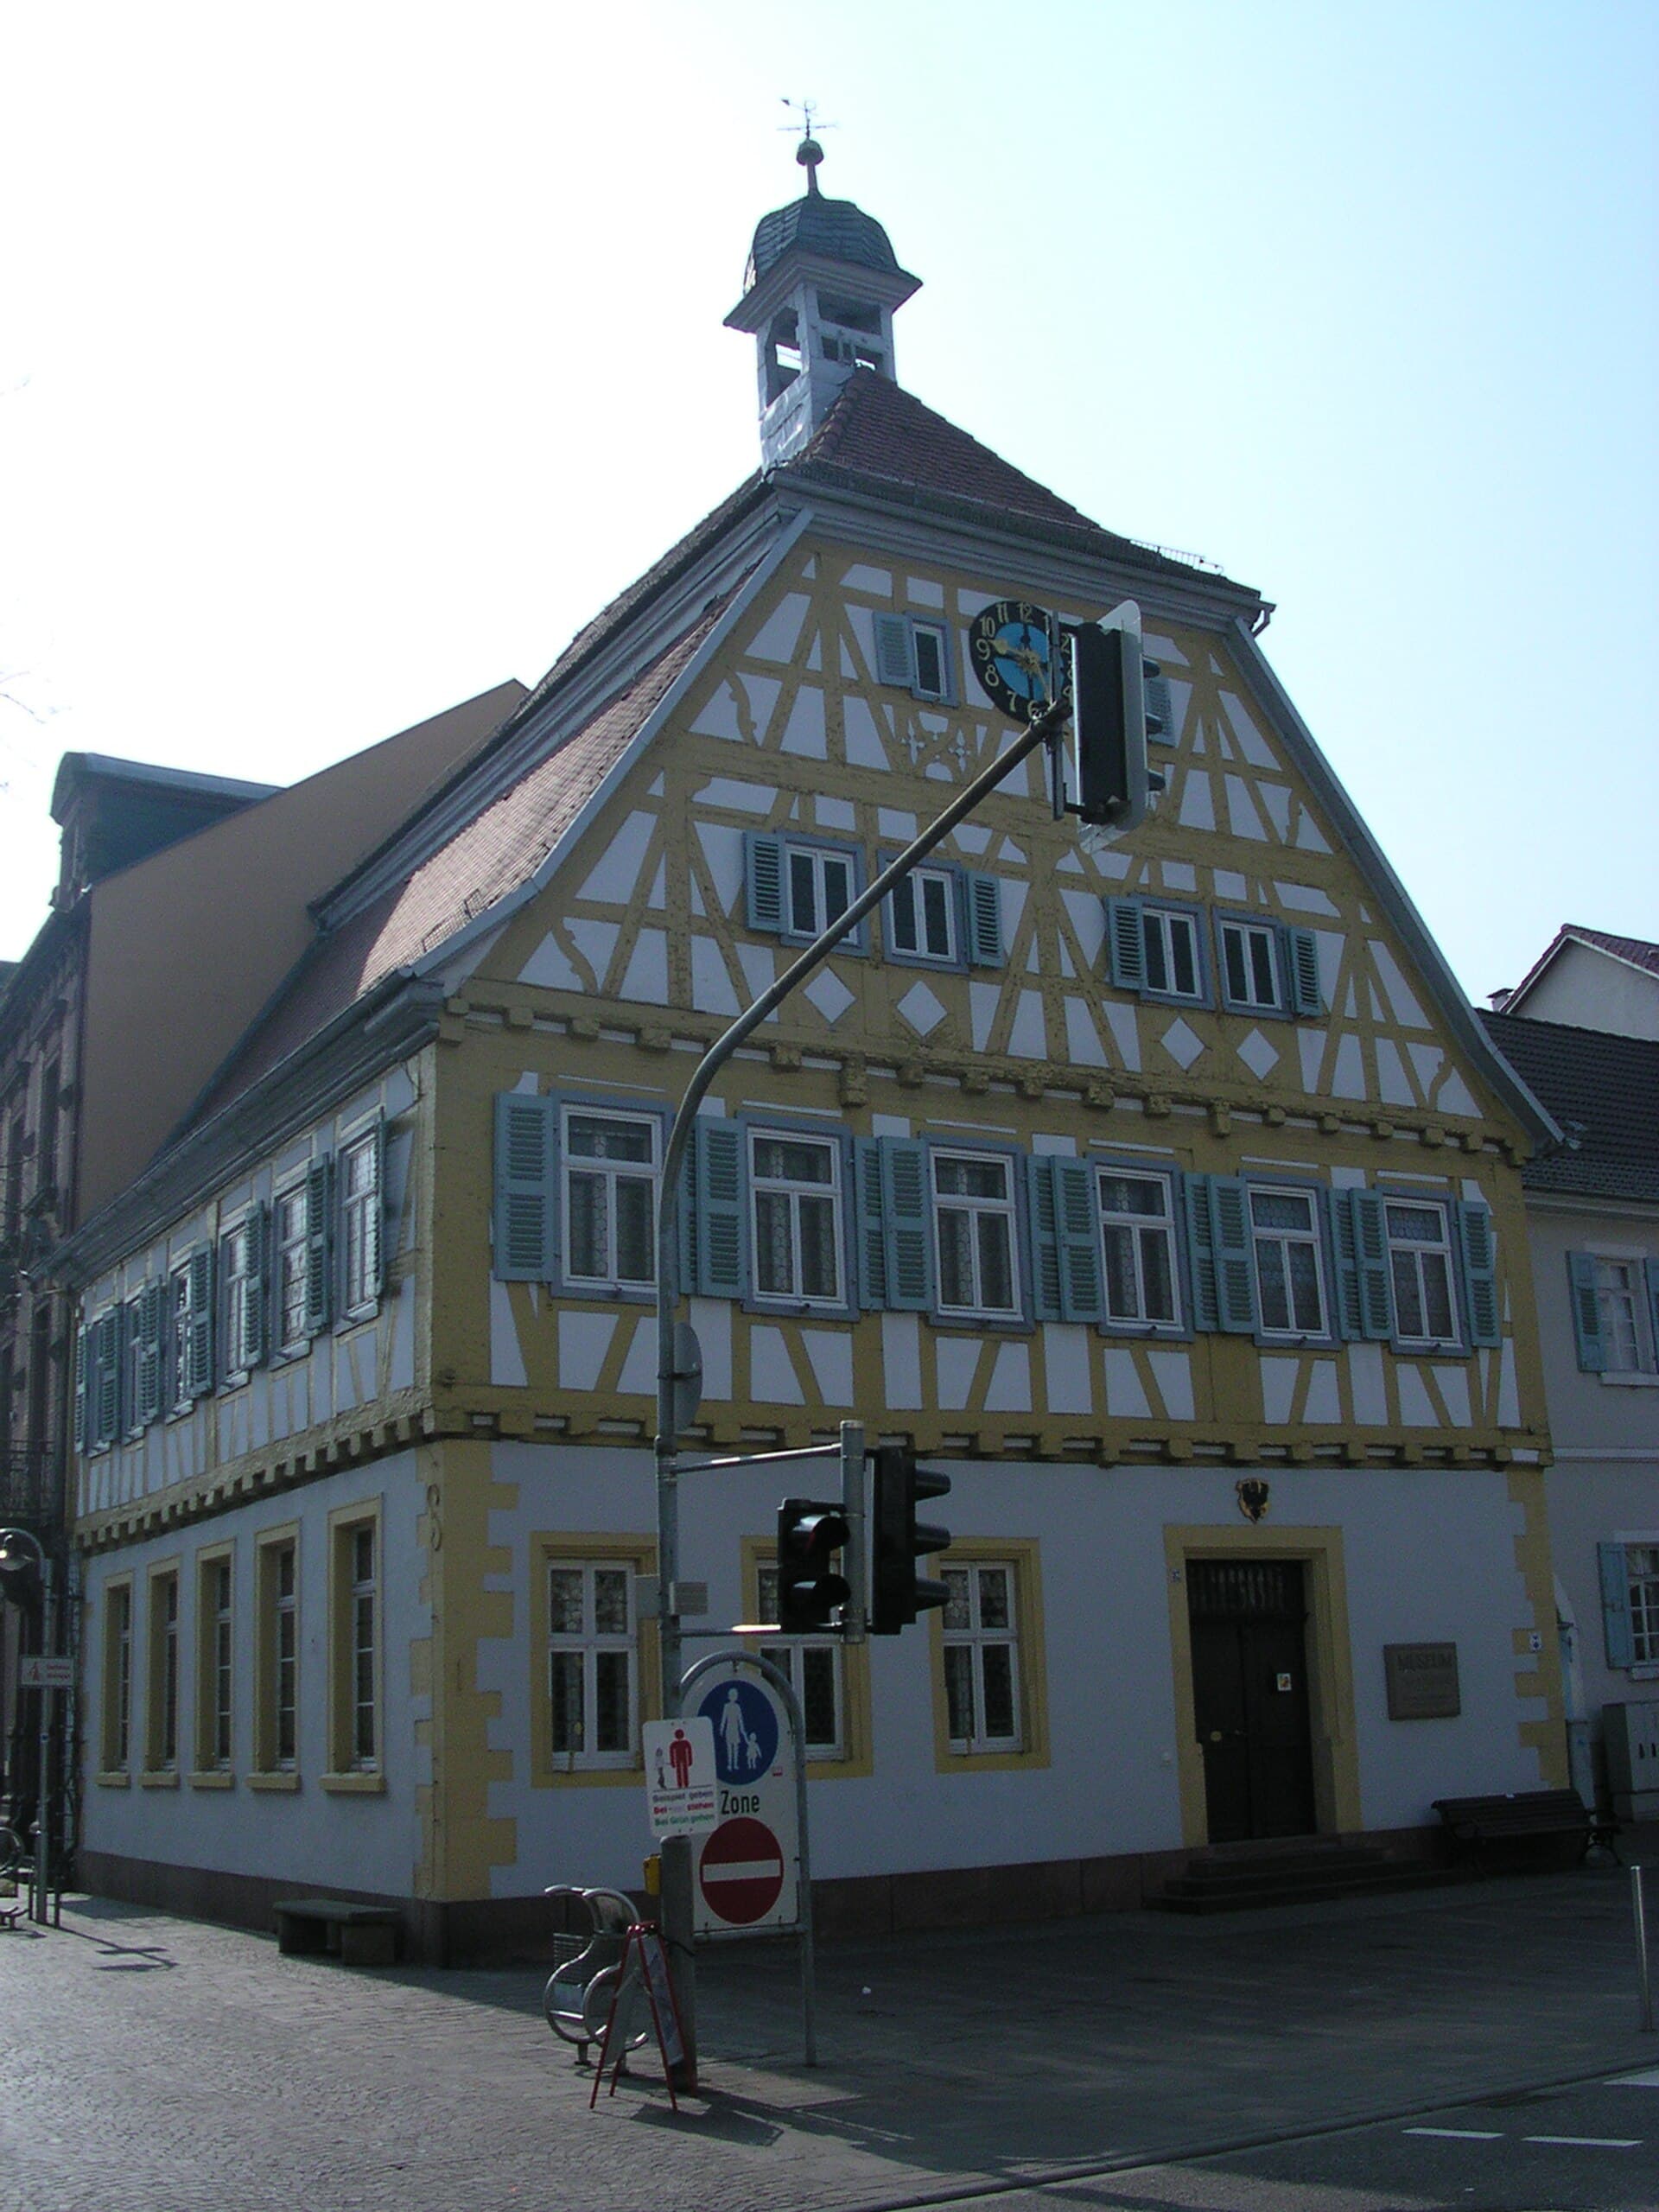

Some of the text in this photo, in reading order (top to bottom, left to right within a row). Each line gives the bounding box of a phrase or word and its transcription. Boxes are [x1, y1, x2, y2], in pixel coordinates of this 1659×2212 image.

[995, 603, 1009, 623] 11
[1016, 602, 1033, 623] 12
[979, 615, 996, 638] 10
[976, 639, 991, 660] 9
[985, 664, 1000, 687] 8
[1007, 690, 1017, 713] 7
[721, 1789, 760, 1815] Zone
